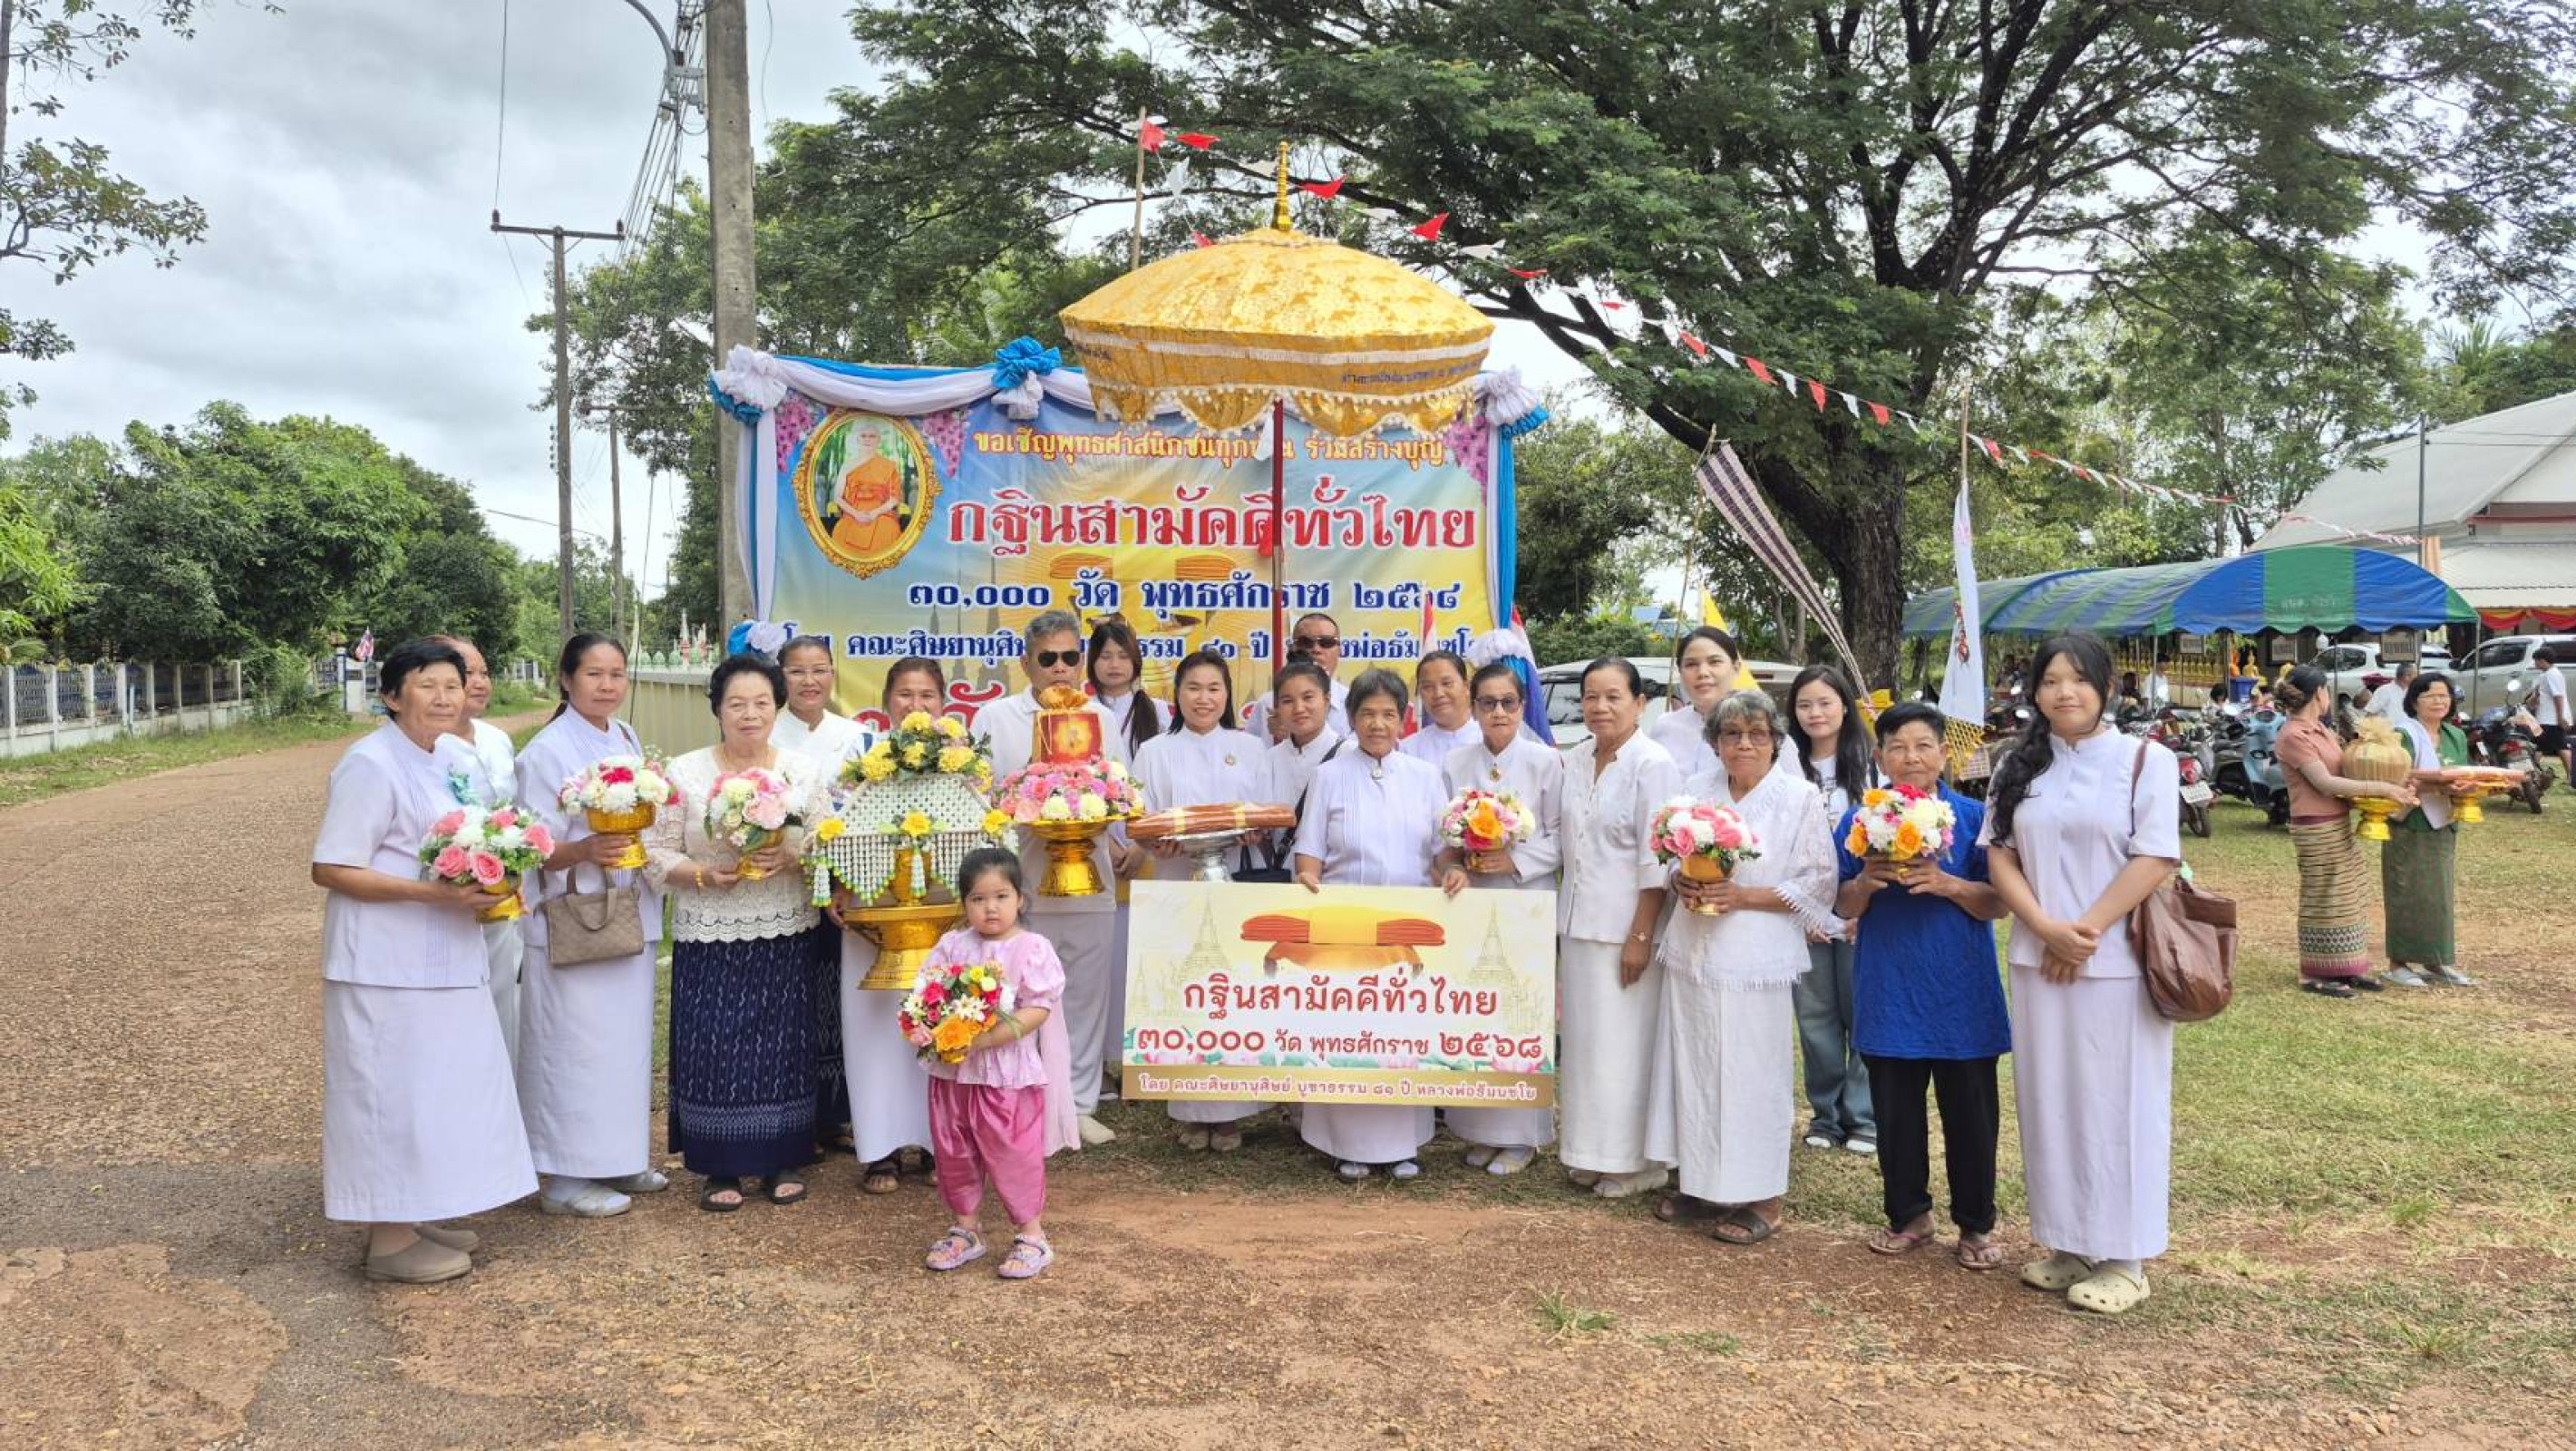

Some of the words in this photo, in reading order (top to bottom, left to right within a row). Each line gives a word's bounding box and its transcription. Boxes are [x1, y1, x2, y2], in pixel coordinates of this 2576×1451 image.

[909, 585, 1050, 606] ๓๐,๐๐๐
[1074, 570, 1120, 607] วัด
[1249, 630, 1270, 658] ปี
[1184, 967, 1497, 1019] กฐินสามัคคีทั่วไทย
[1138, 1028, 1265, 1055] ๓๐,๐๐๐
[1275, 1028, 1302, 1052] วัด
[1310, 1030, 1429, 1060] พุทธศักราช
[1440, 1032, 1542, 1059] ๒๕๖๘
[1139, 1074, 1169, 1091] โดย
[1174, 1076, 1292, 1097] คณะศิษยานุศิษย์
[1298, 1080, 1366, 1097] บูชาธรรม
[1401, 1079, 1412, 1096] ปี
